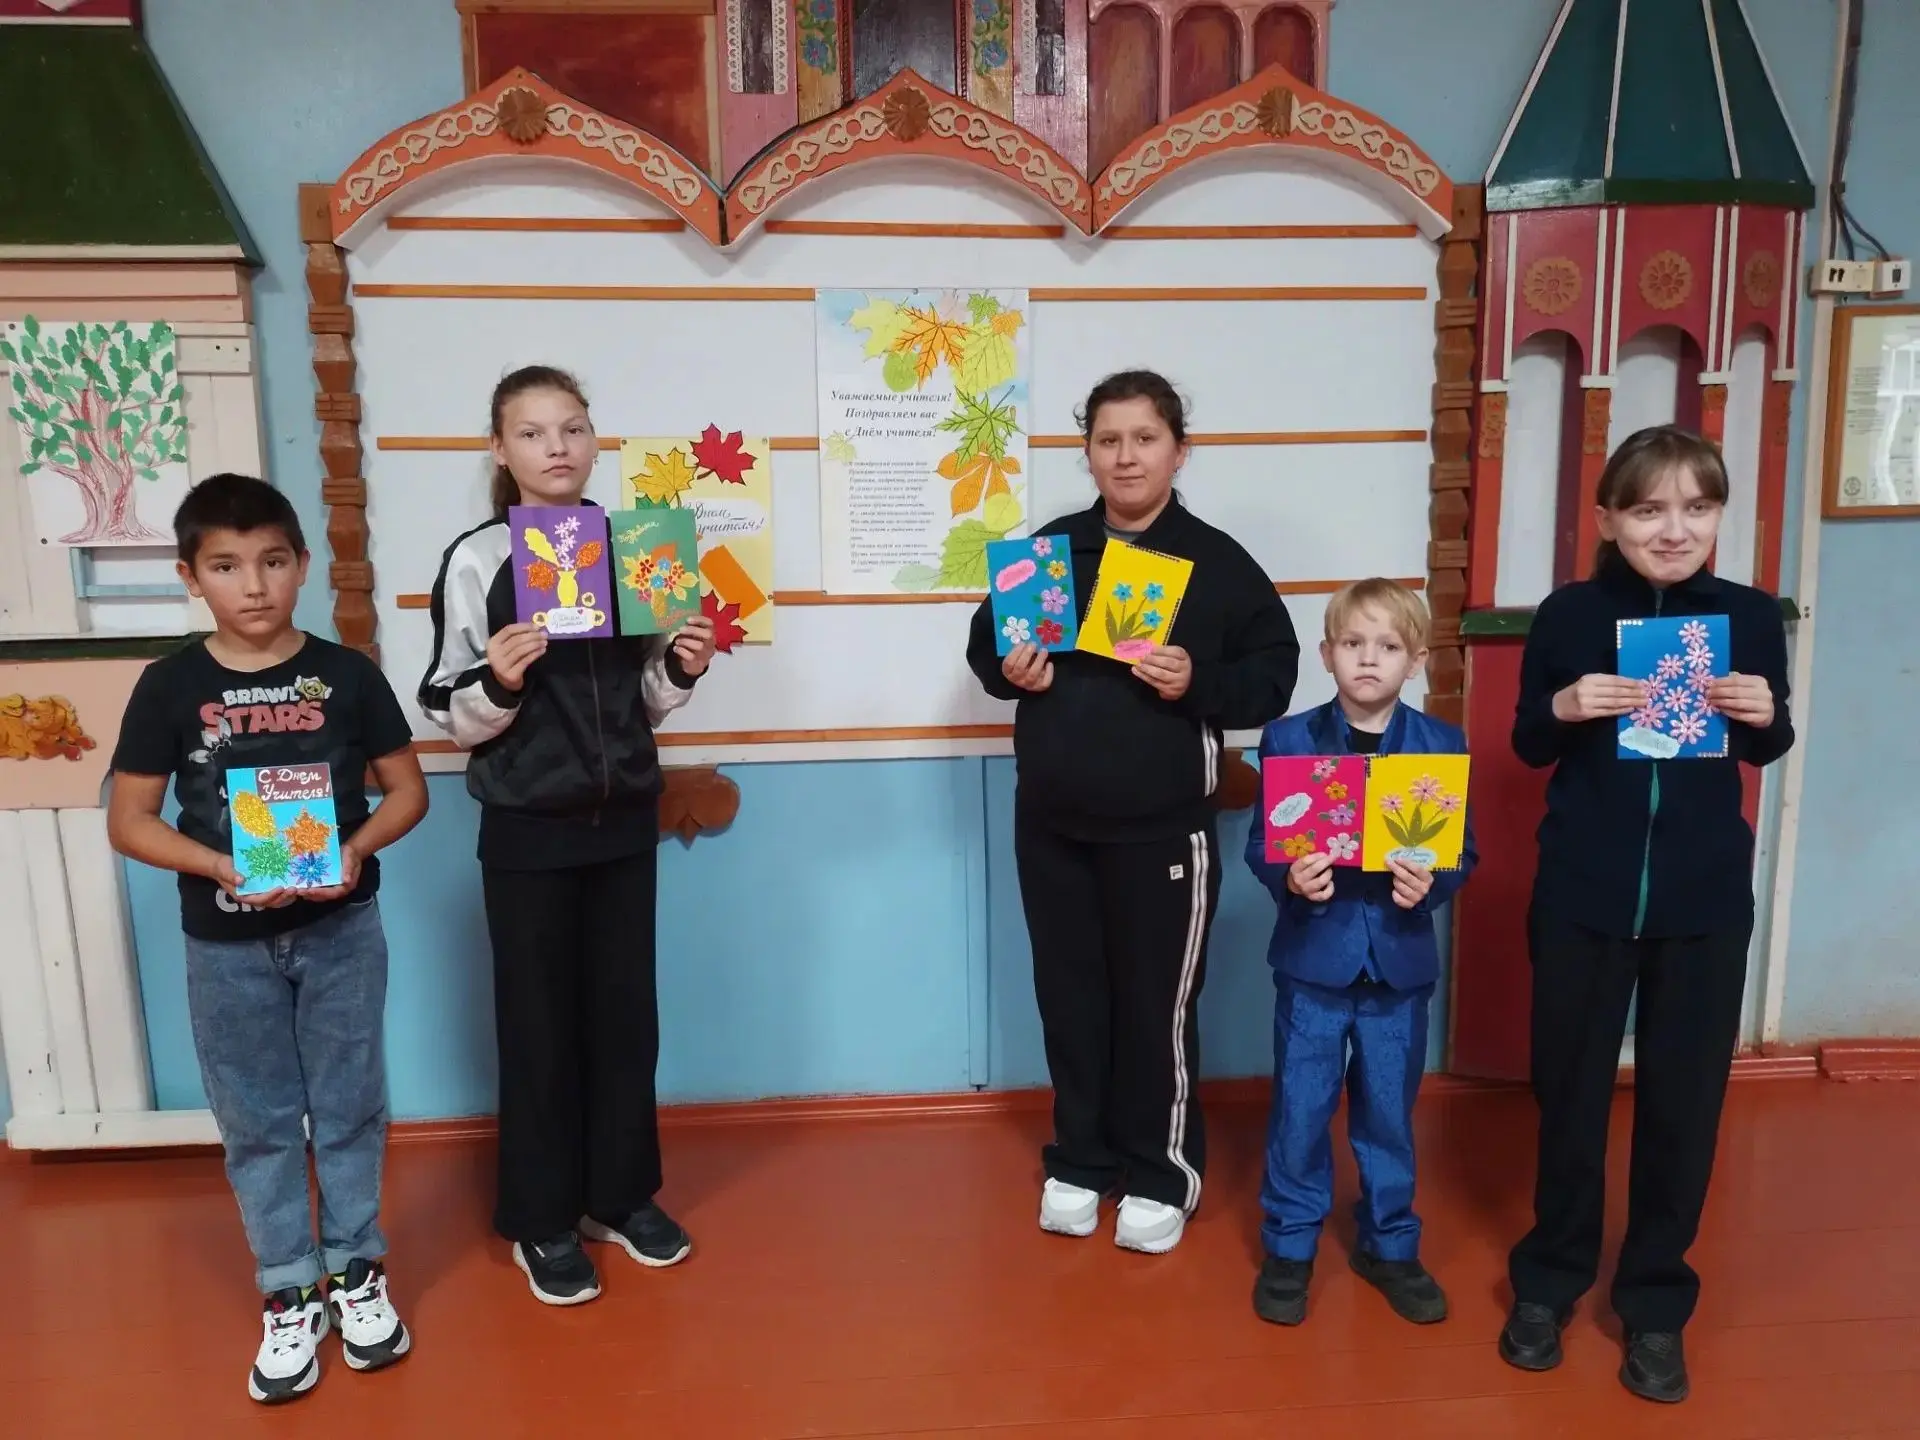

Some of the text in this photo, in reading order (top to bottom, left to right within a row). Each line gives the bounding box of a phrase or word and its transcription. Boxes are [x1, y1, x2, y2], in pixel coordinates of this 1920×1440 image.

[831, 390, 952, 404] Уважаемые учителя!
[919, 411, 938, 419] вас
[844, 428, 851, 437] с
[886, 426, 937, 438] учителя!
[222, 686, 300, 707] BRAWL
[200, 700, 325, 736] STARS
[258, 769, 272, 783] С
[261, 782, 330, 801] Учителя!
